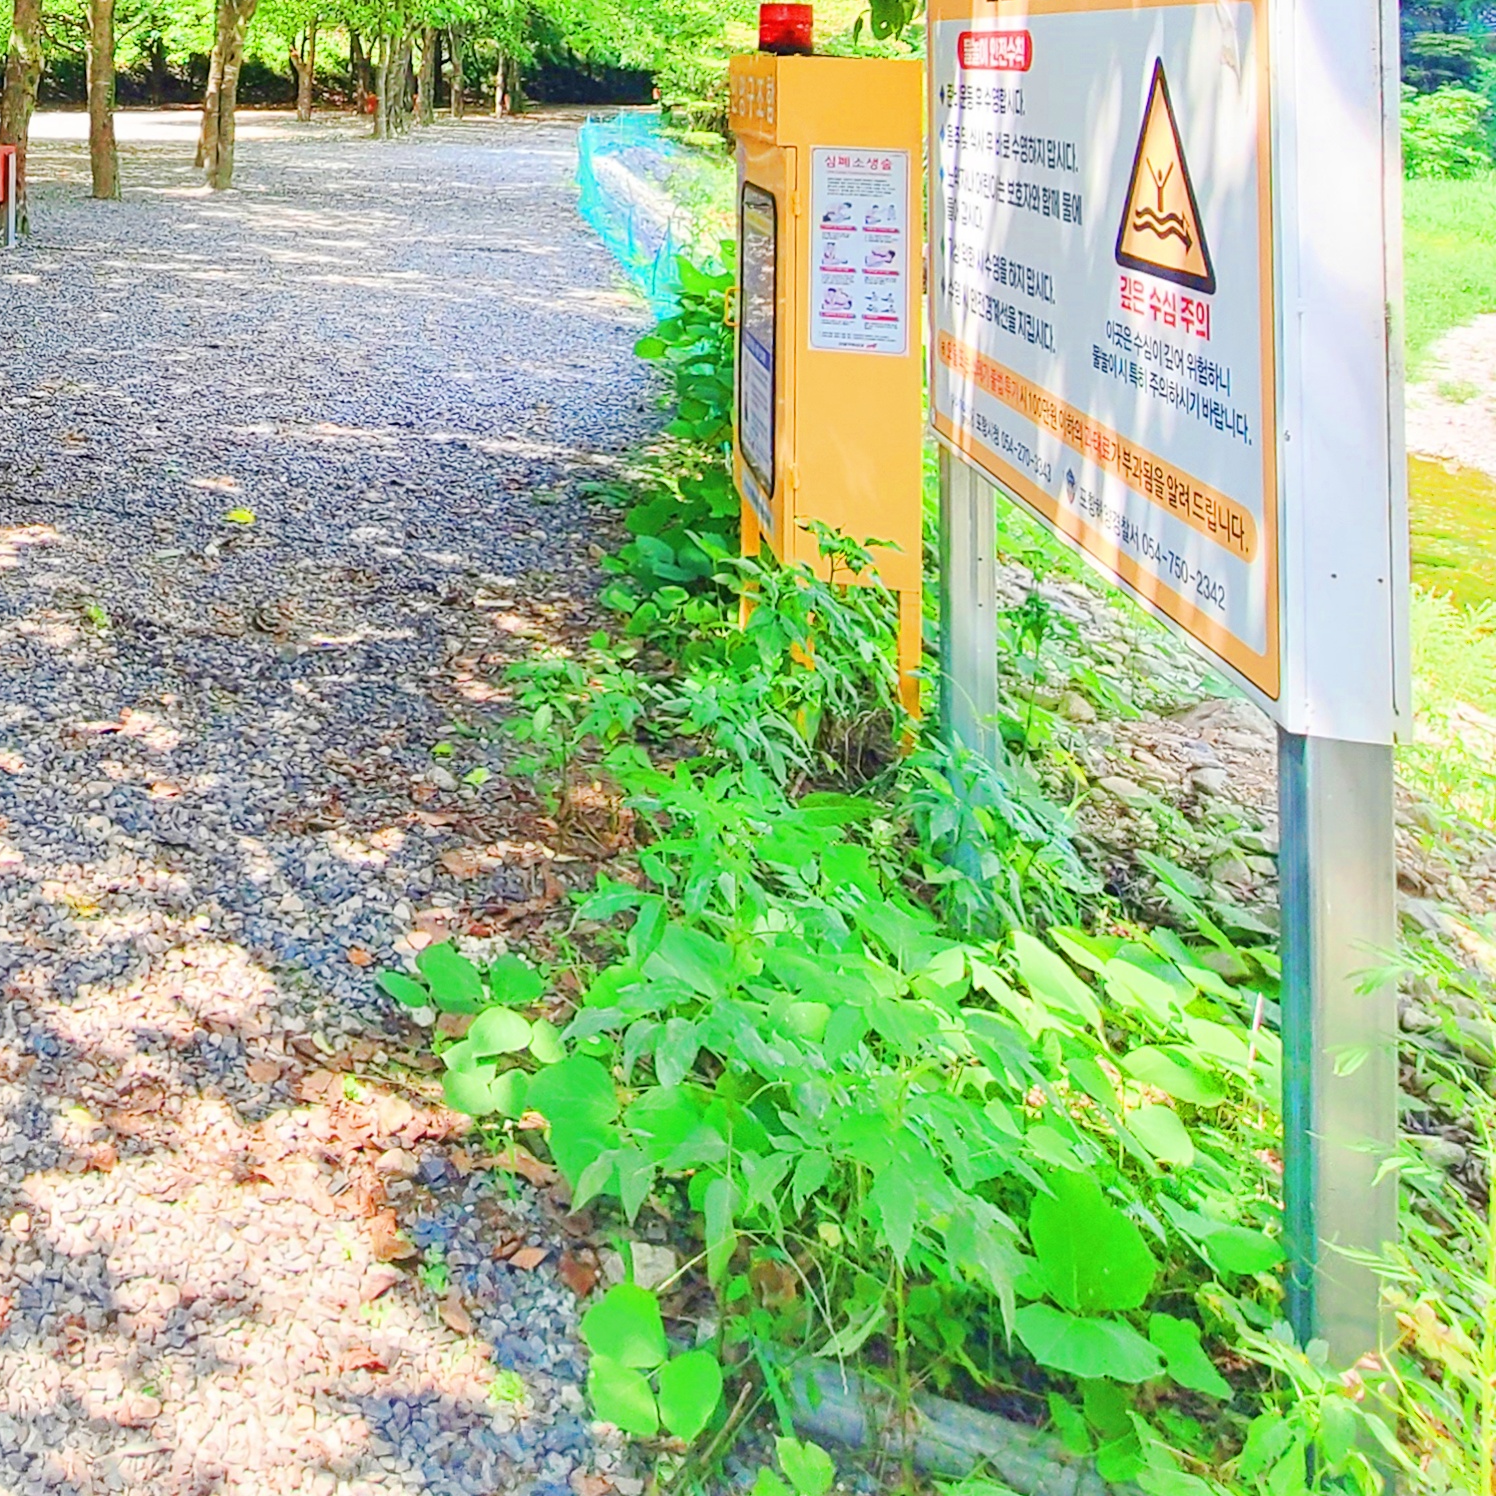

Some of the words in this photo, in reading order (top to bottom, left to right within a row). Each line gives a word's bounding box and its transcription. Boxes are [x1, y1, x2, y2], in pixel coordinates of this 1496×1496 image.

[964, 38, 988, 64] 물놀이
[990, 38, 1024, 65] 안전수칙
[824, 156, 892, 170] 심폐소생술
[1012, 135, 1044, 166] 수영하지
[1047, 140, 1078, 172] 맙시다.
[1007, 179, 1039, 212] 보호자와
[1042, 187, 1059, 218] 함께
[1062, 191, 1082, 224] 물에
[985, 251, 1006, 284] 수영을
[1006, 259, 1024, 291] 하지
[1026, 267, 1054, 304] 맙시다.
[1017, 309, 1055, 353] 지킵시다.
[1120, 276, 1144, 315] 깊은
[1150, 286, 1175, 326] 수심
[1180, 296, 1210, 339] 주의
[1106, 319, 1132, 352] 이곳은
[1134, 331, 1161, 365] 수심이
[1164, 343, 1183, 375] 깊어
[1186, 352, 1230, 395] 위험하니
[1092, 344, 1116, 379] 물놀이
[1118, 356, 1127, 384] 시
[1129, 361, 1147, 393] 특히
[1149, 370, 1199, 419] 주의하시기
[1202, 394, 1252, 444] 바랍니다.
[1122, 443, 1164, 499] 부과됨을
[1166, 469, 1189, 515] 알려
[1192, 483, 1249, 551] 드립니다.
[1142, 529, 1225, 612] 054-750-2342
